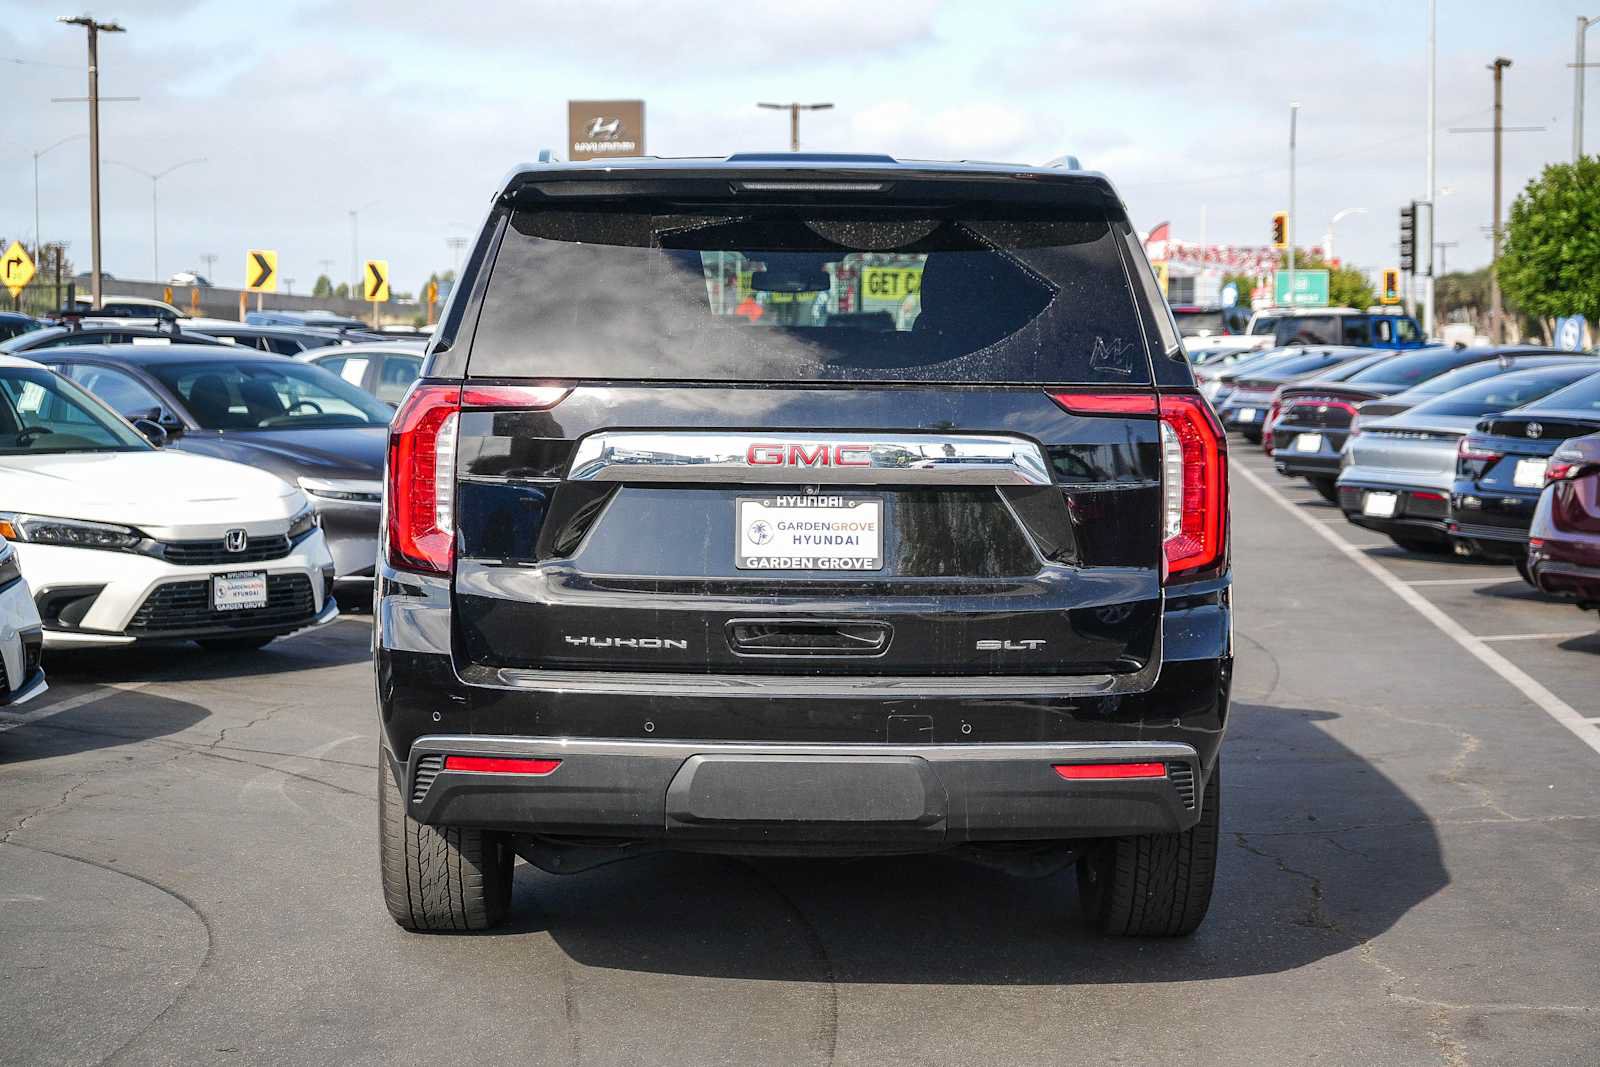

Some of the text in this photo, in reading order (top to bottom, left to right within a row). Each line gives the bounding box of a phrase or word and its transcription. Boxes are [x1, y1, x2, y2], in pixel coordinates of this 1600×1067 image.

[870, 271, 898, 295] GET
[746, 442, 871, 467] GMC
[776, 495, 843, 508] HYUNDAI
[793, 534, 860, 546] HYUNDAI
[746, 556, 873, 570] GARDEN GROVE
[565, 635, 688, 649] YUKON
[976, 639, 1047, 650] SLT
